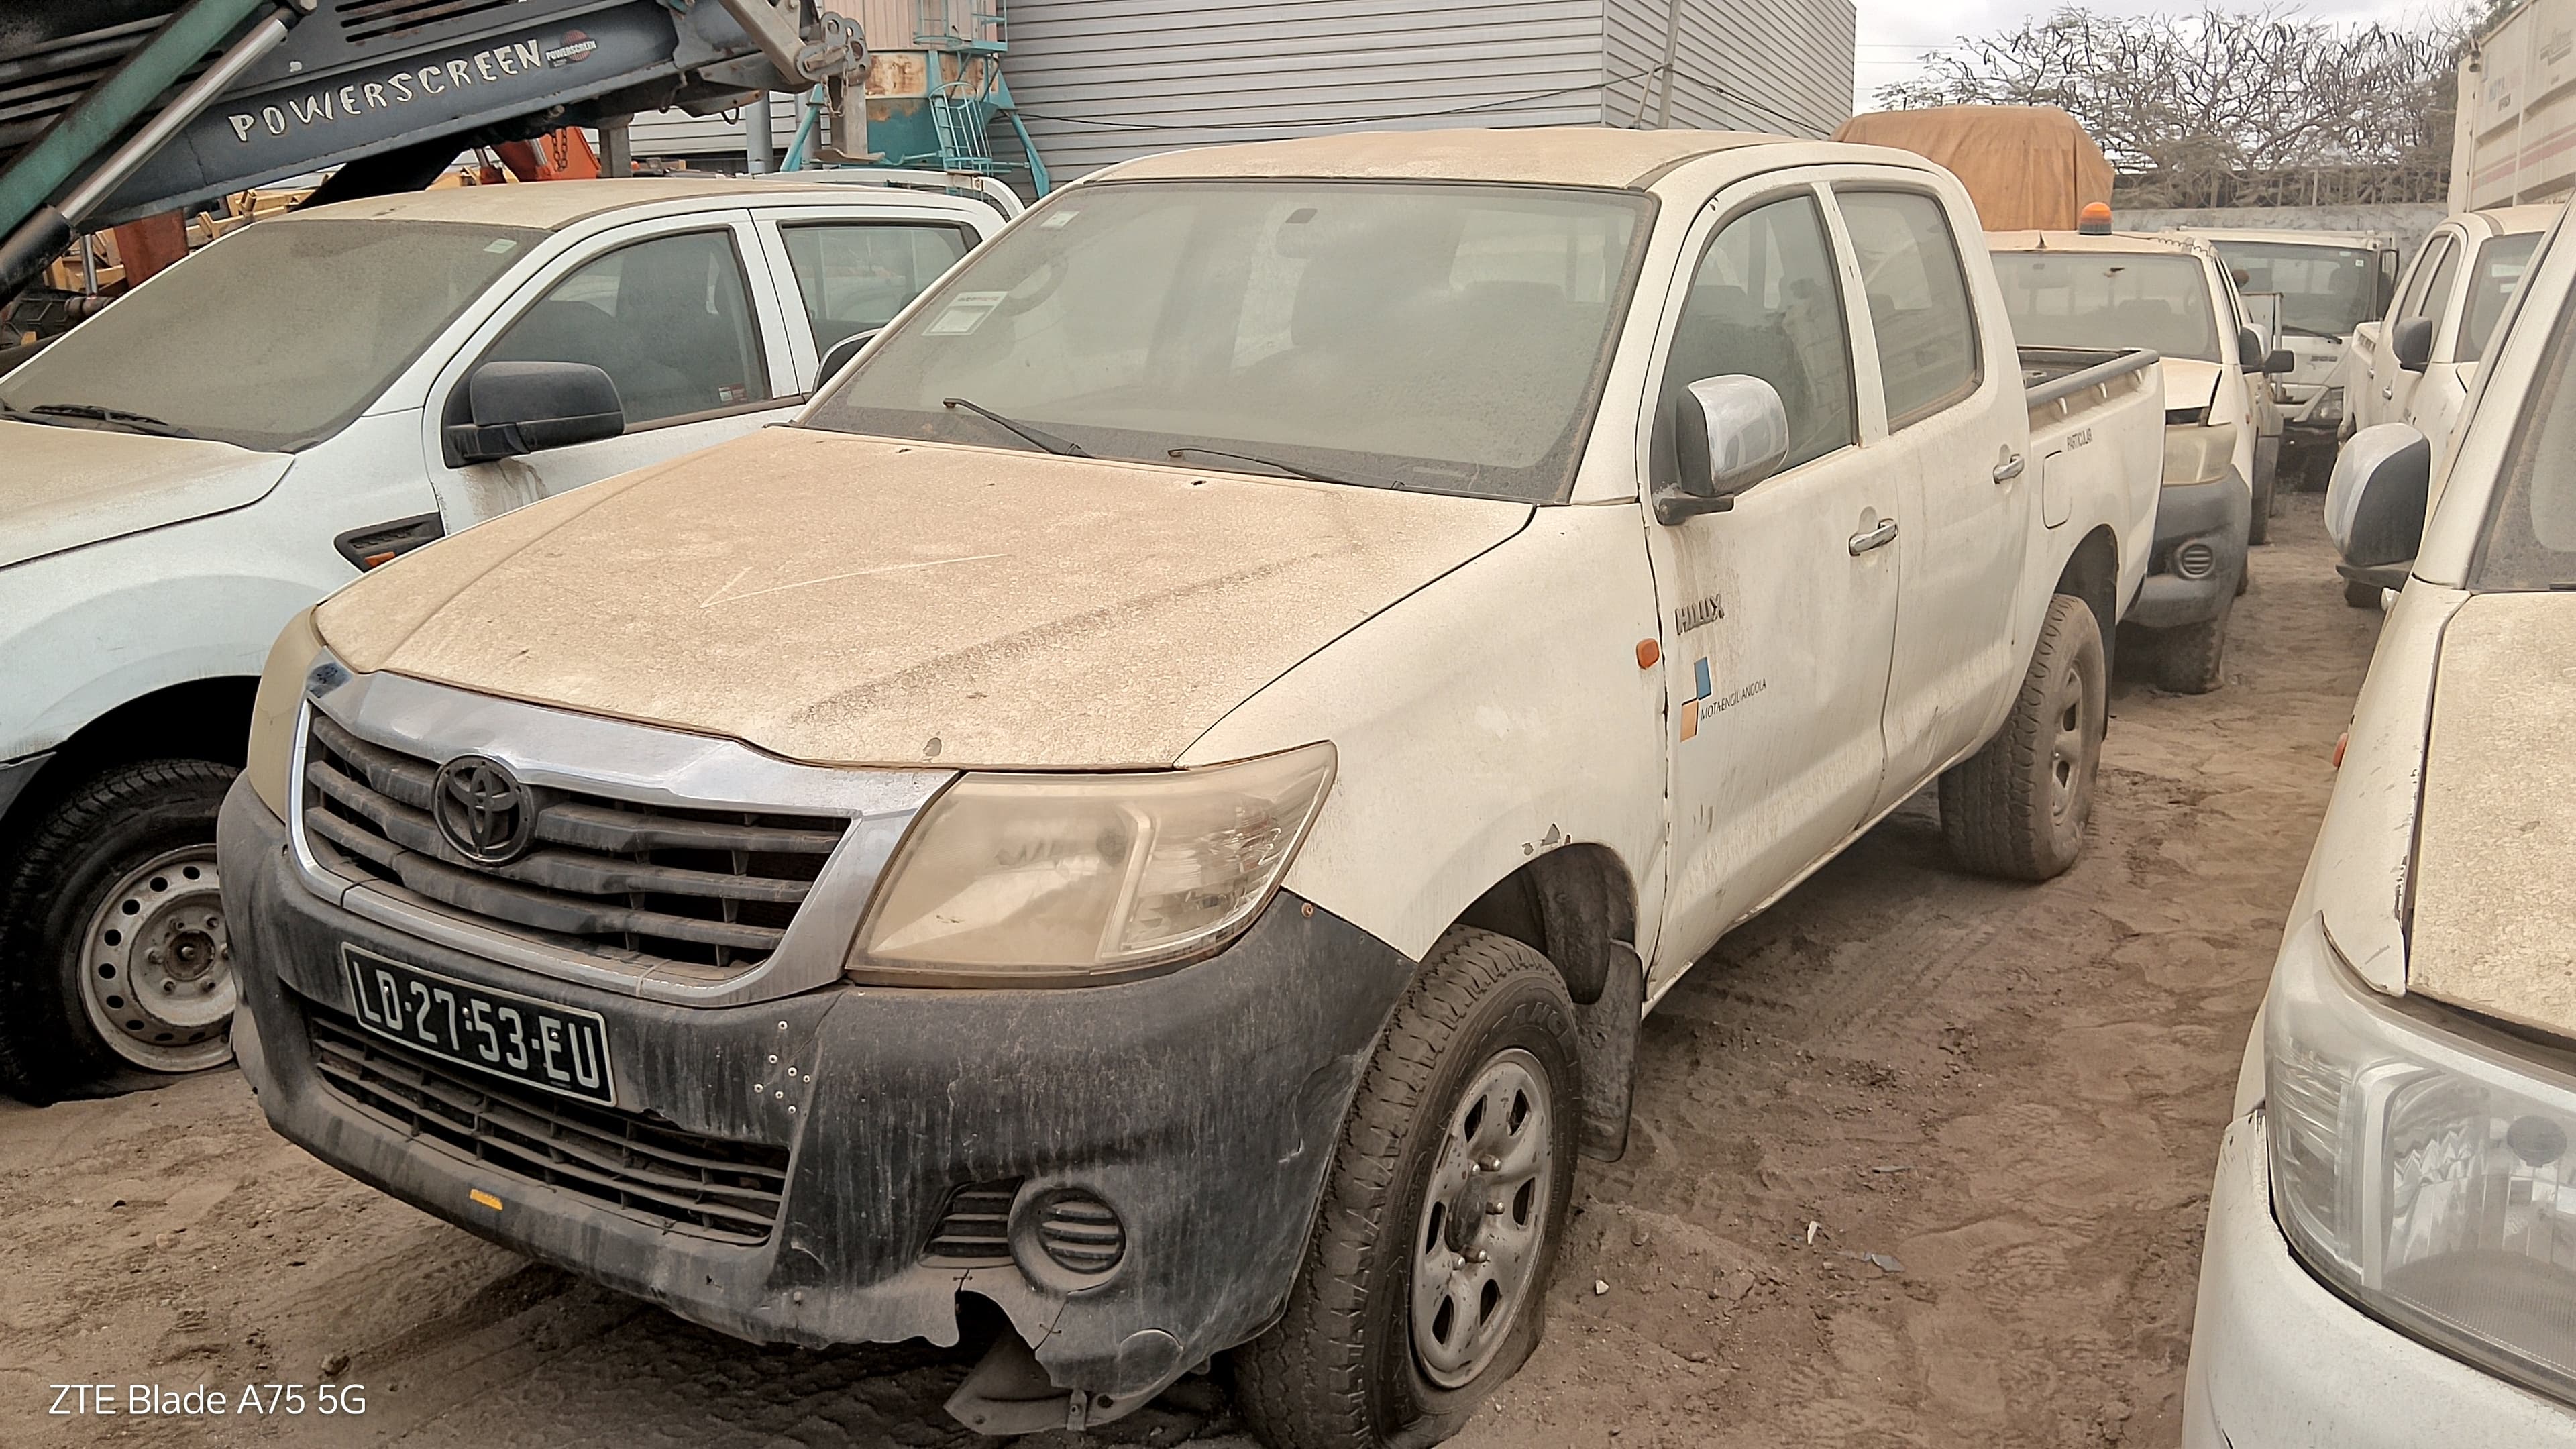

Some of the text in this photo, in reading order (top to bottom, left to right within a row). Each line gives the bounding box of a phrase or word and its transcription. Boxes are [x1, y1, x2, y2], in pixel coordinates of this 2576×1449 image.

[545, 40, 597, 61] POWERSCREEN
[229, 39, 541, 142] POWERSCREEN
[1674, 593, 1725, 636] HILUX
[1741, 678, 1766, 700] ANGOLA
